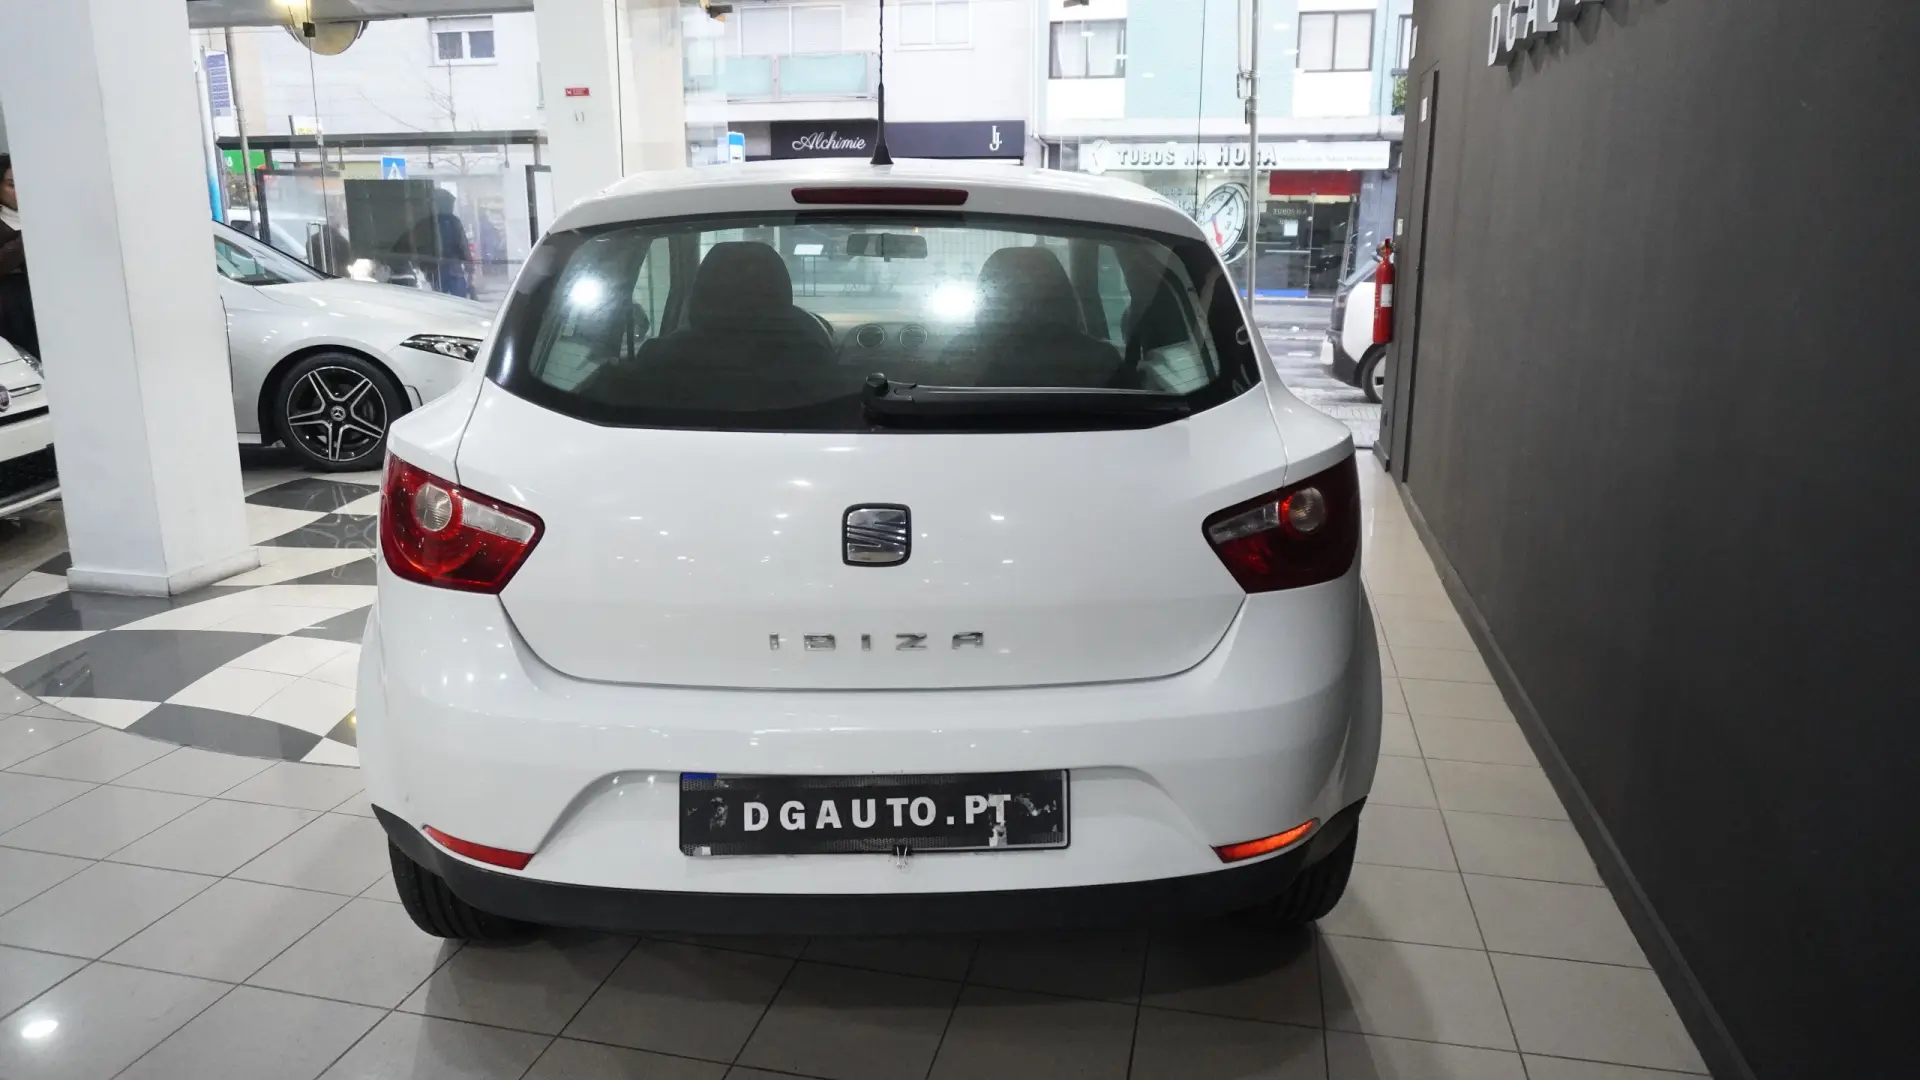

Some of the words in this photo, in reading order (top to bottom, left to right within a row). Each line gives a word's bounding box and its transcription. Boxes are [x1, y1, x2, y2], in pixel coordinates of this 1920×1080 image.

[791, 130, 867, 151] Alchimie
[1118, 149, 1177, 166] TUBOS
[1184, 148, 1207, 166] NA
[769, 632, 984, 651] IBIZA
[743, 794, 1011, 831] DGAUTO.PT
